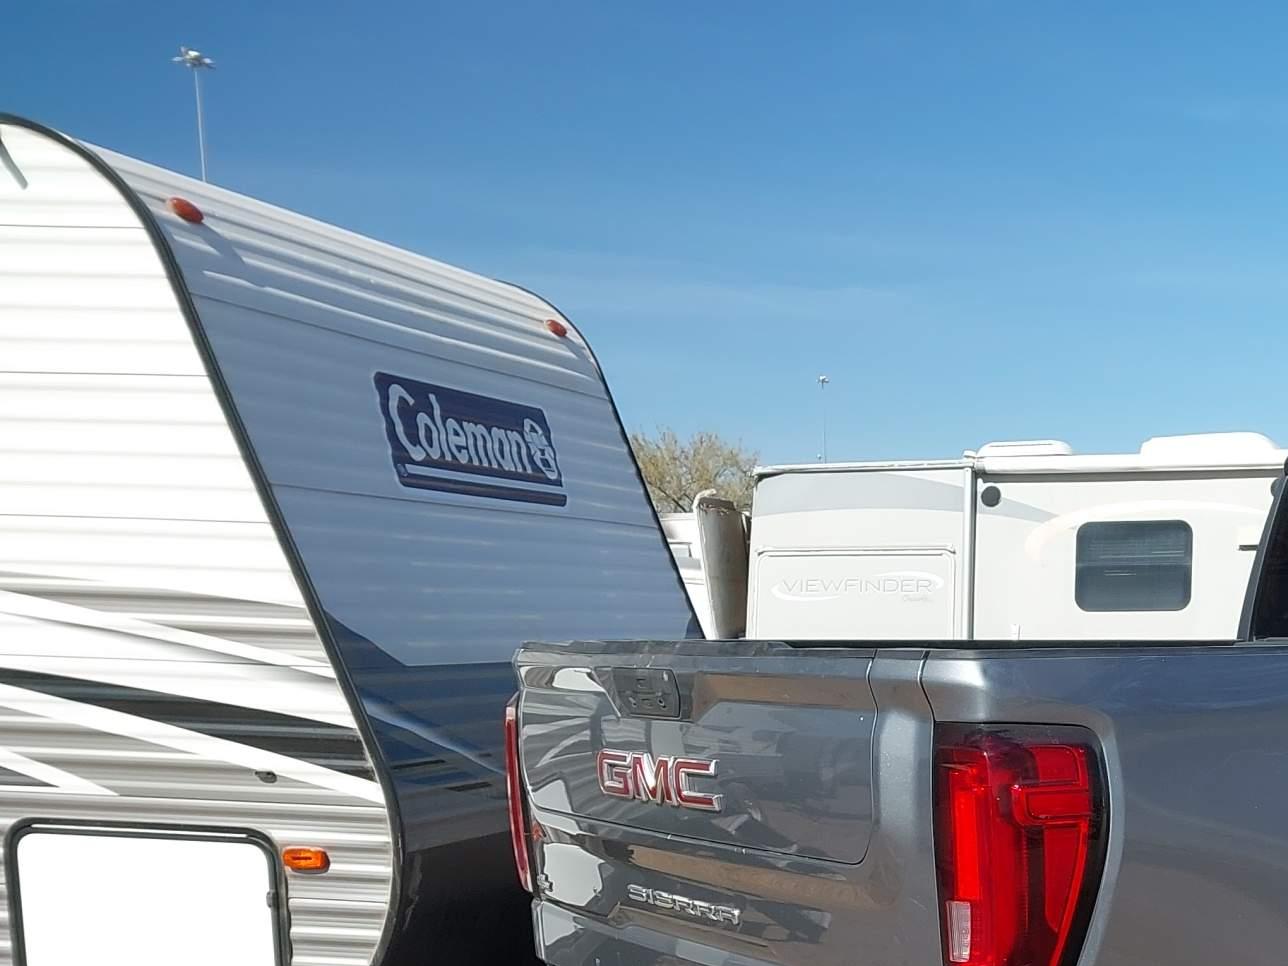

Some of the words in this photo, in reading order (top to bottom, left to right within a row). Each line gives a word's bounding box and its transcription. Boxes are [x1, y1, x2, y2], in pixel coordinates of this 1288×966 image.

[389, 384, 533, 473] Coleman
[782, 578, 933, 593] VIEWFINDER
[597, 749, 724, 811] GMC
[627, 884, 741, 926] SIERRA
